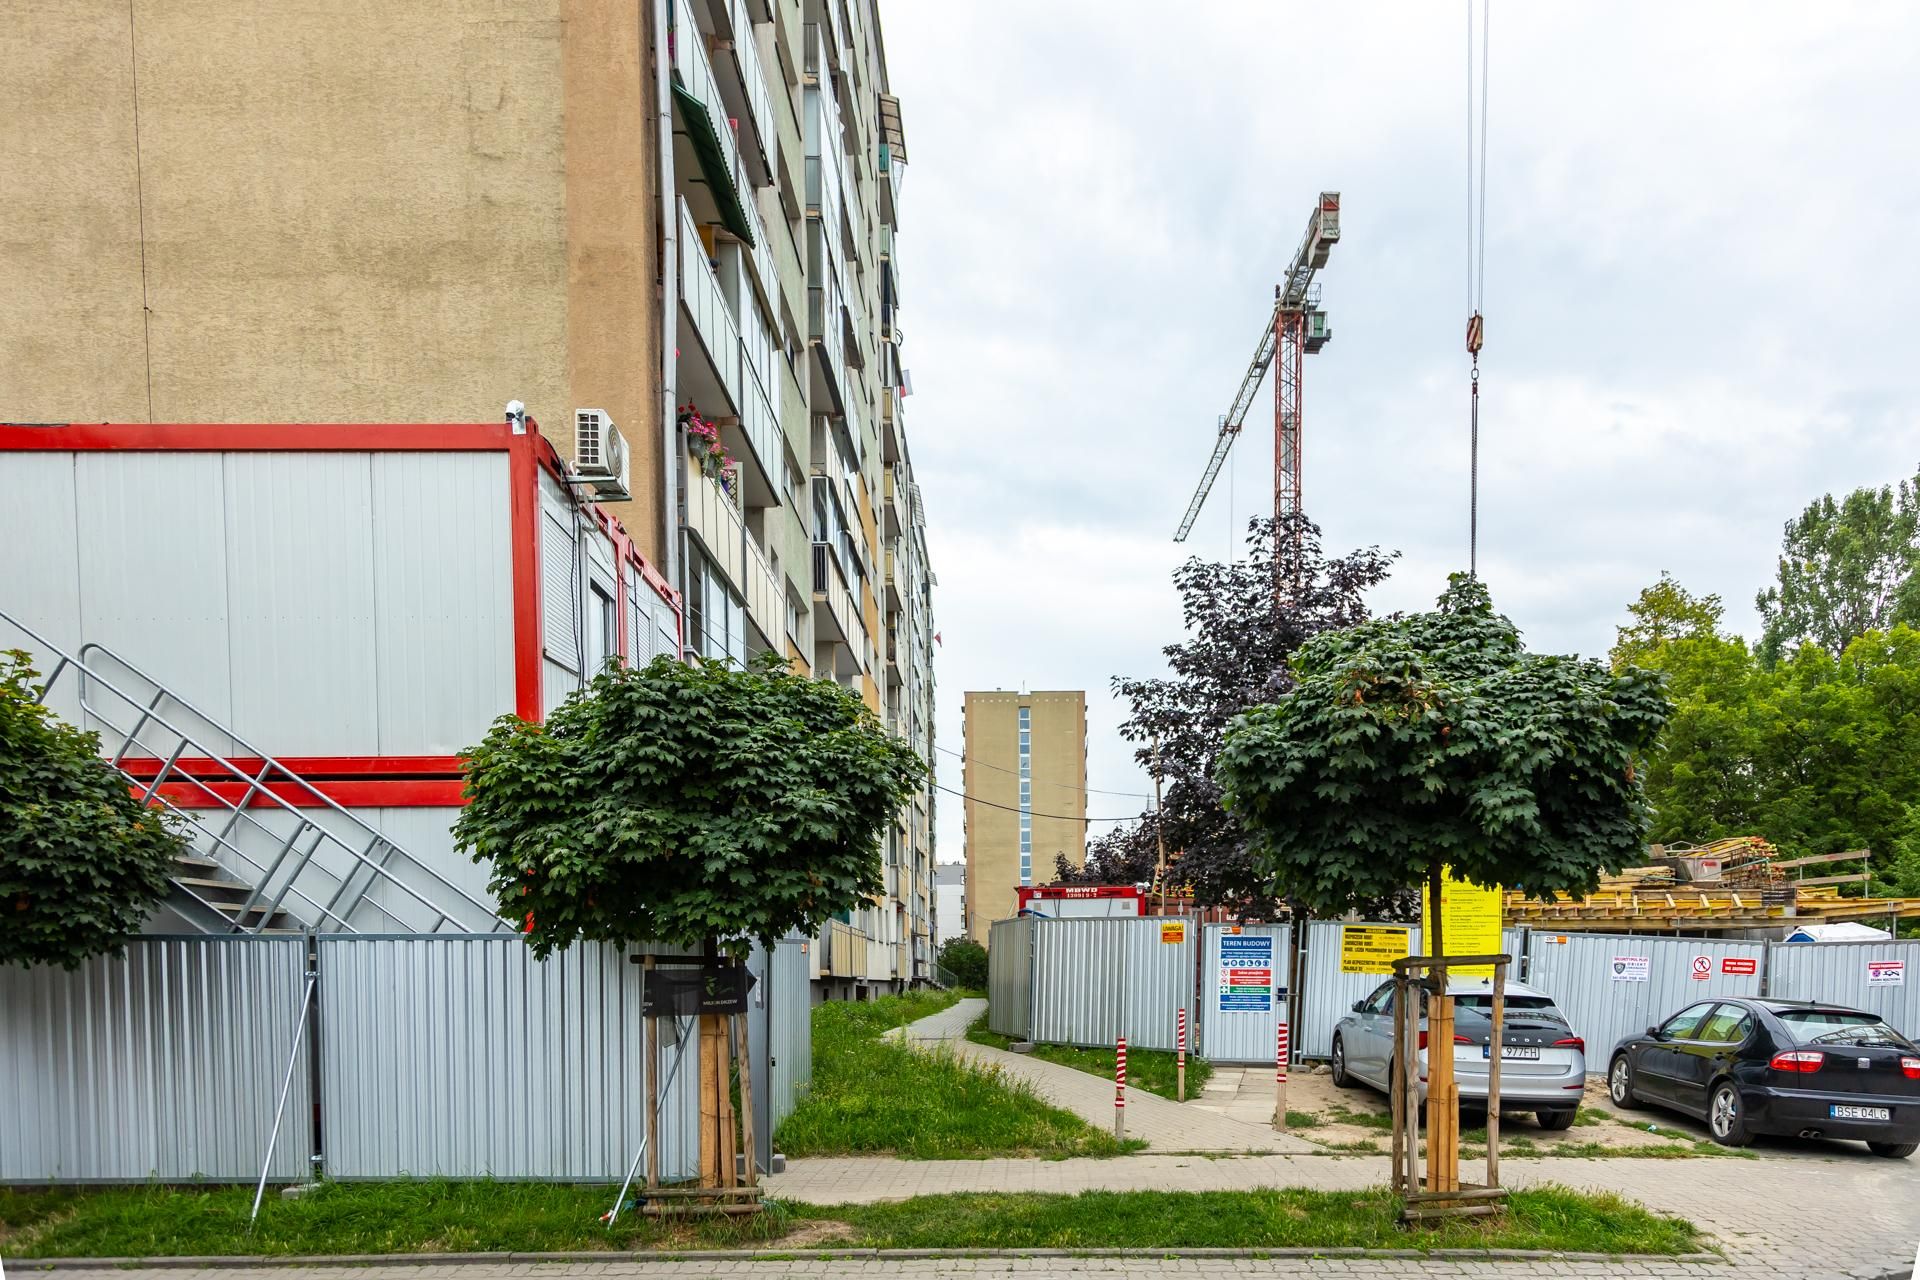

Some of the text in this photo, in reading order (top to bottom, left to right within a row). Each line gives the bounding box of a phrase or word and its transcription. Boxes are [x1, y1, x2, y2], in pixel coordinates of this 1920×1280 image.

[1506, 1047, 1537, 1057] 977FH
[1837, 1106, 1858, 1117] BSE
[1861, 1108, 1887, 1119] 04LG
